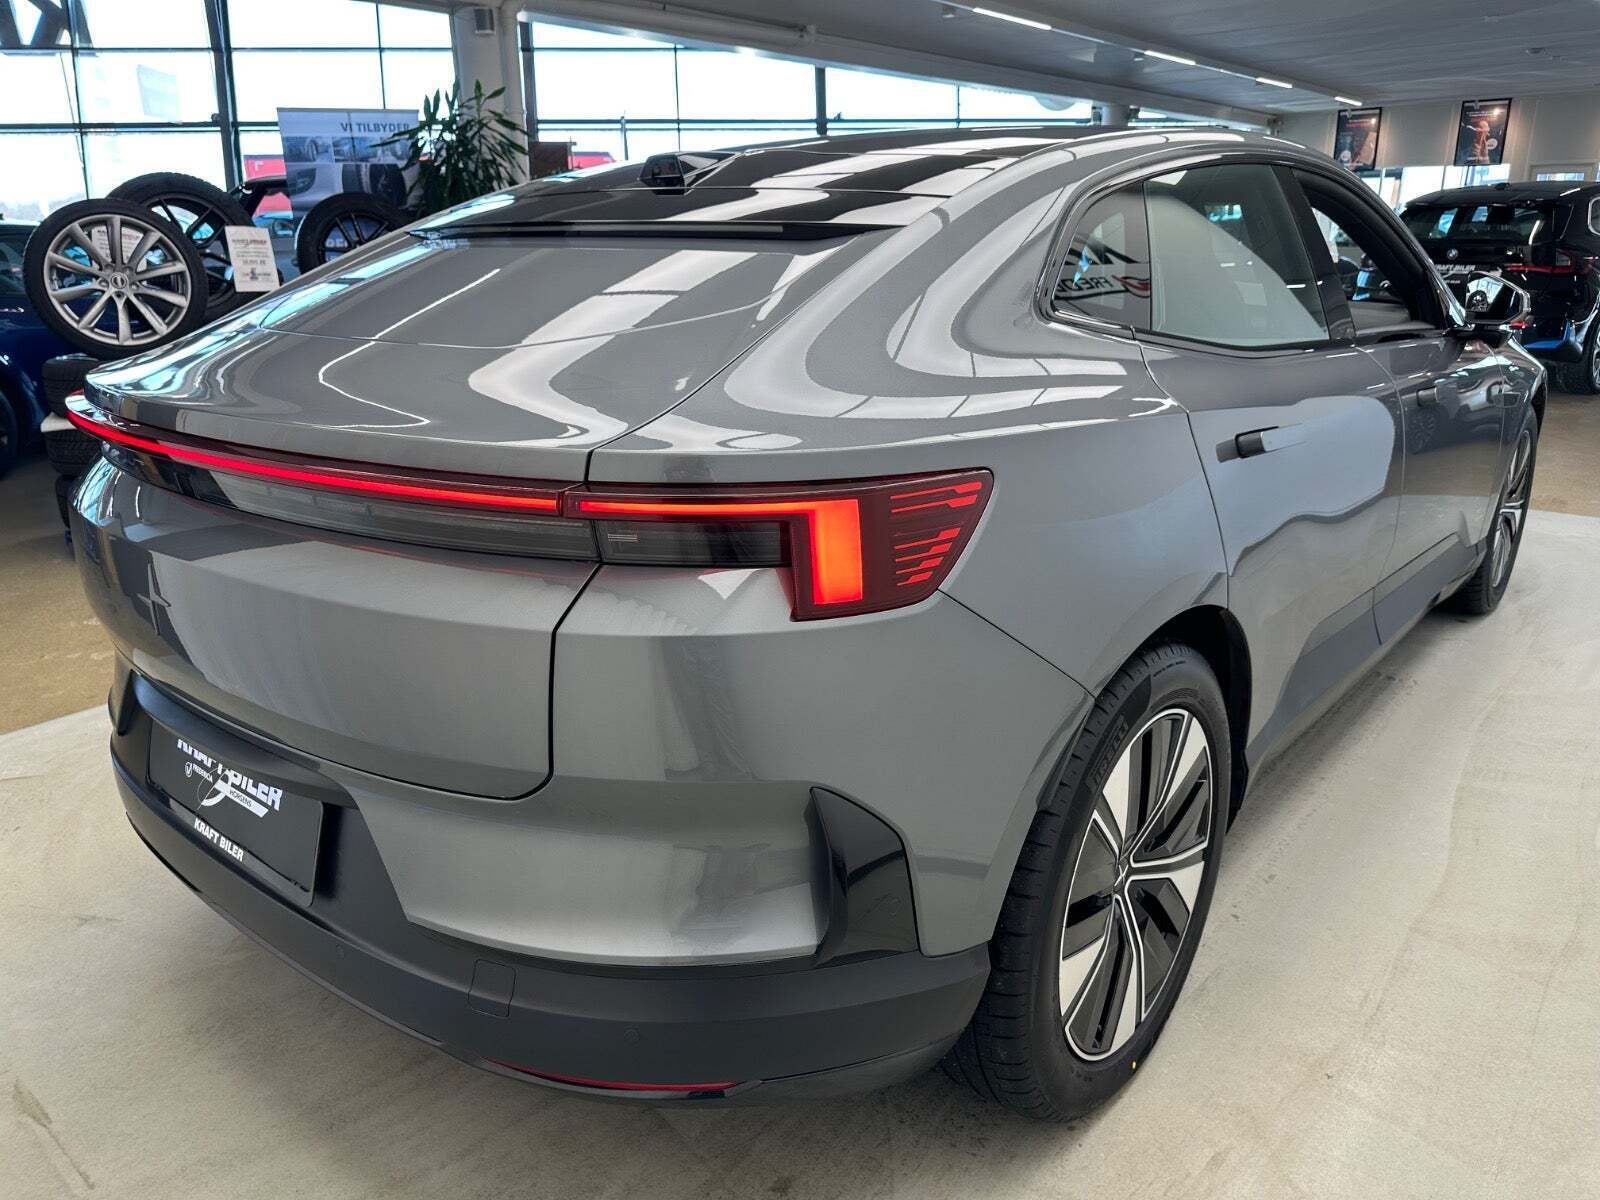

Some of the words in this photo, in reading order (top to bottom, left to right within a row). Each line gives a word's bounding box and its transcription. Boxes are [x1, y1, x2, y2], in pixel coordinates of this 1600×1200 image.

[340, 122, 353, 132] VI
[194, 818, 220, 843] KRAFT
[219, 835, 244, 862] BILER
